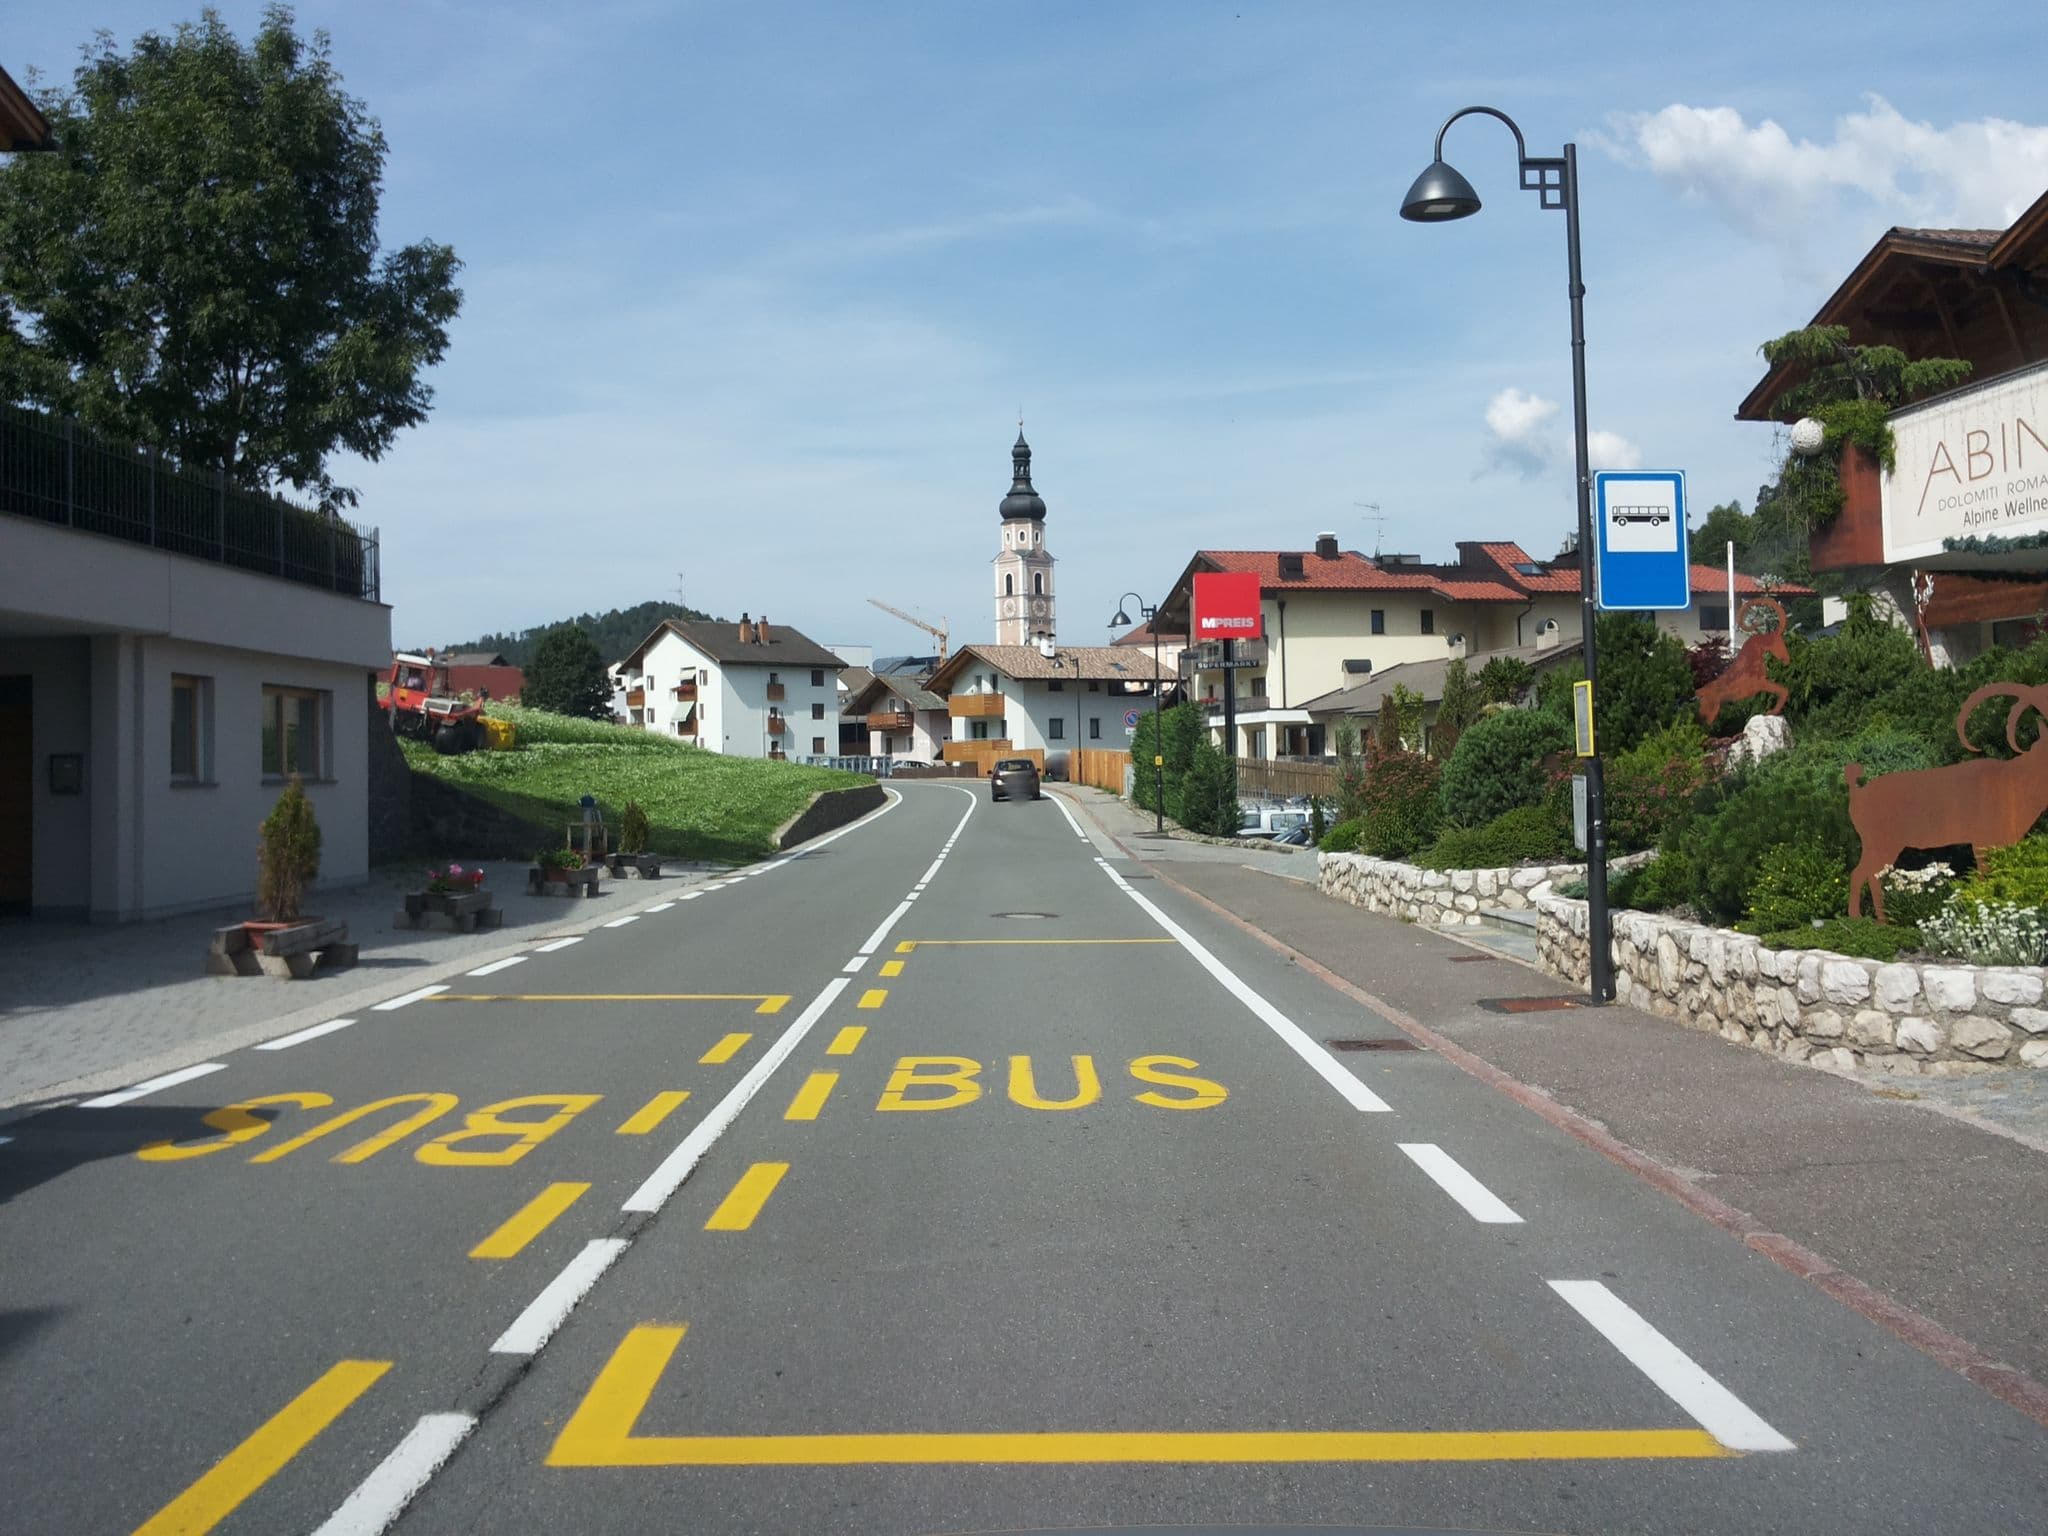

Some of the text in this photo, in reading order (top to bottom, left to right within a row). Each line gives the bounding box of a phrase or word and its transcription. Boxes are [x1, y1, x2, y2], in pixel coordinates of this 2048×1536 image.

[1938, 486, 1999, 512] DOLOMITI
[1963, 507, 1999, 528] Alpine
[1201, 617, 1255, 629] MPREIS
[875, 1054, 1229, 1111] BUS
